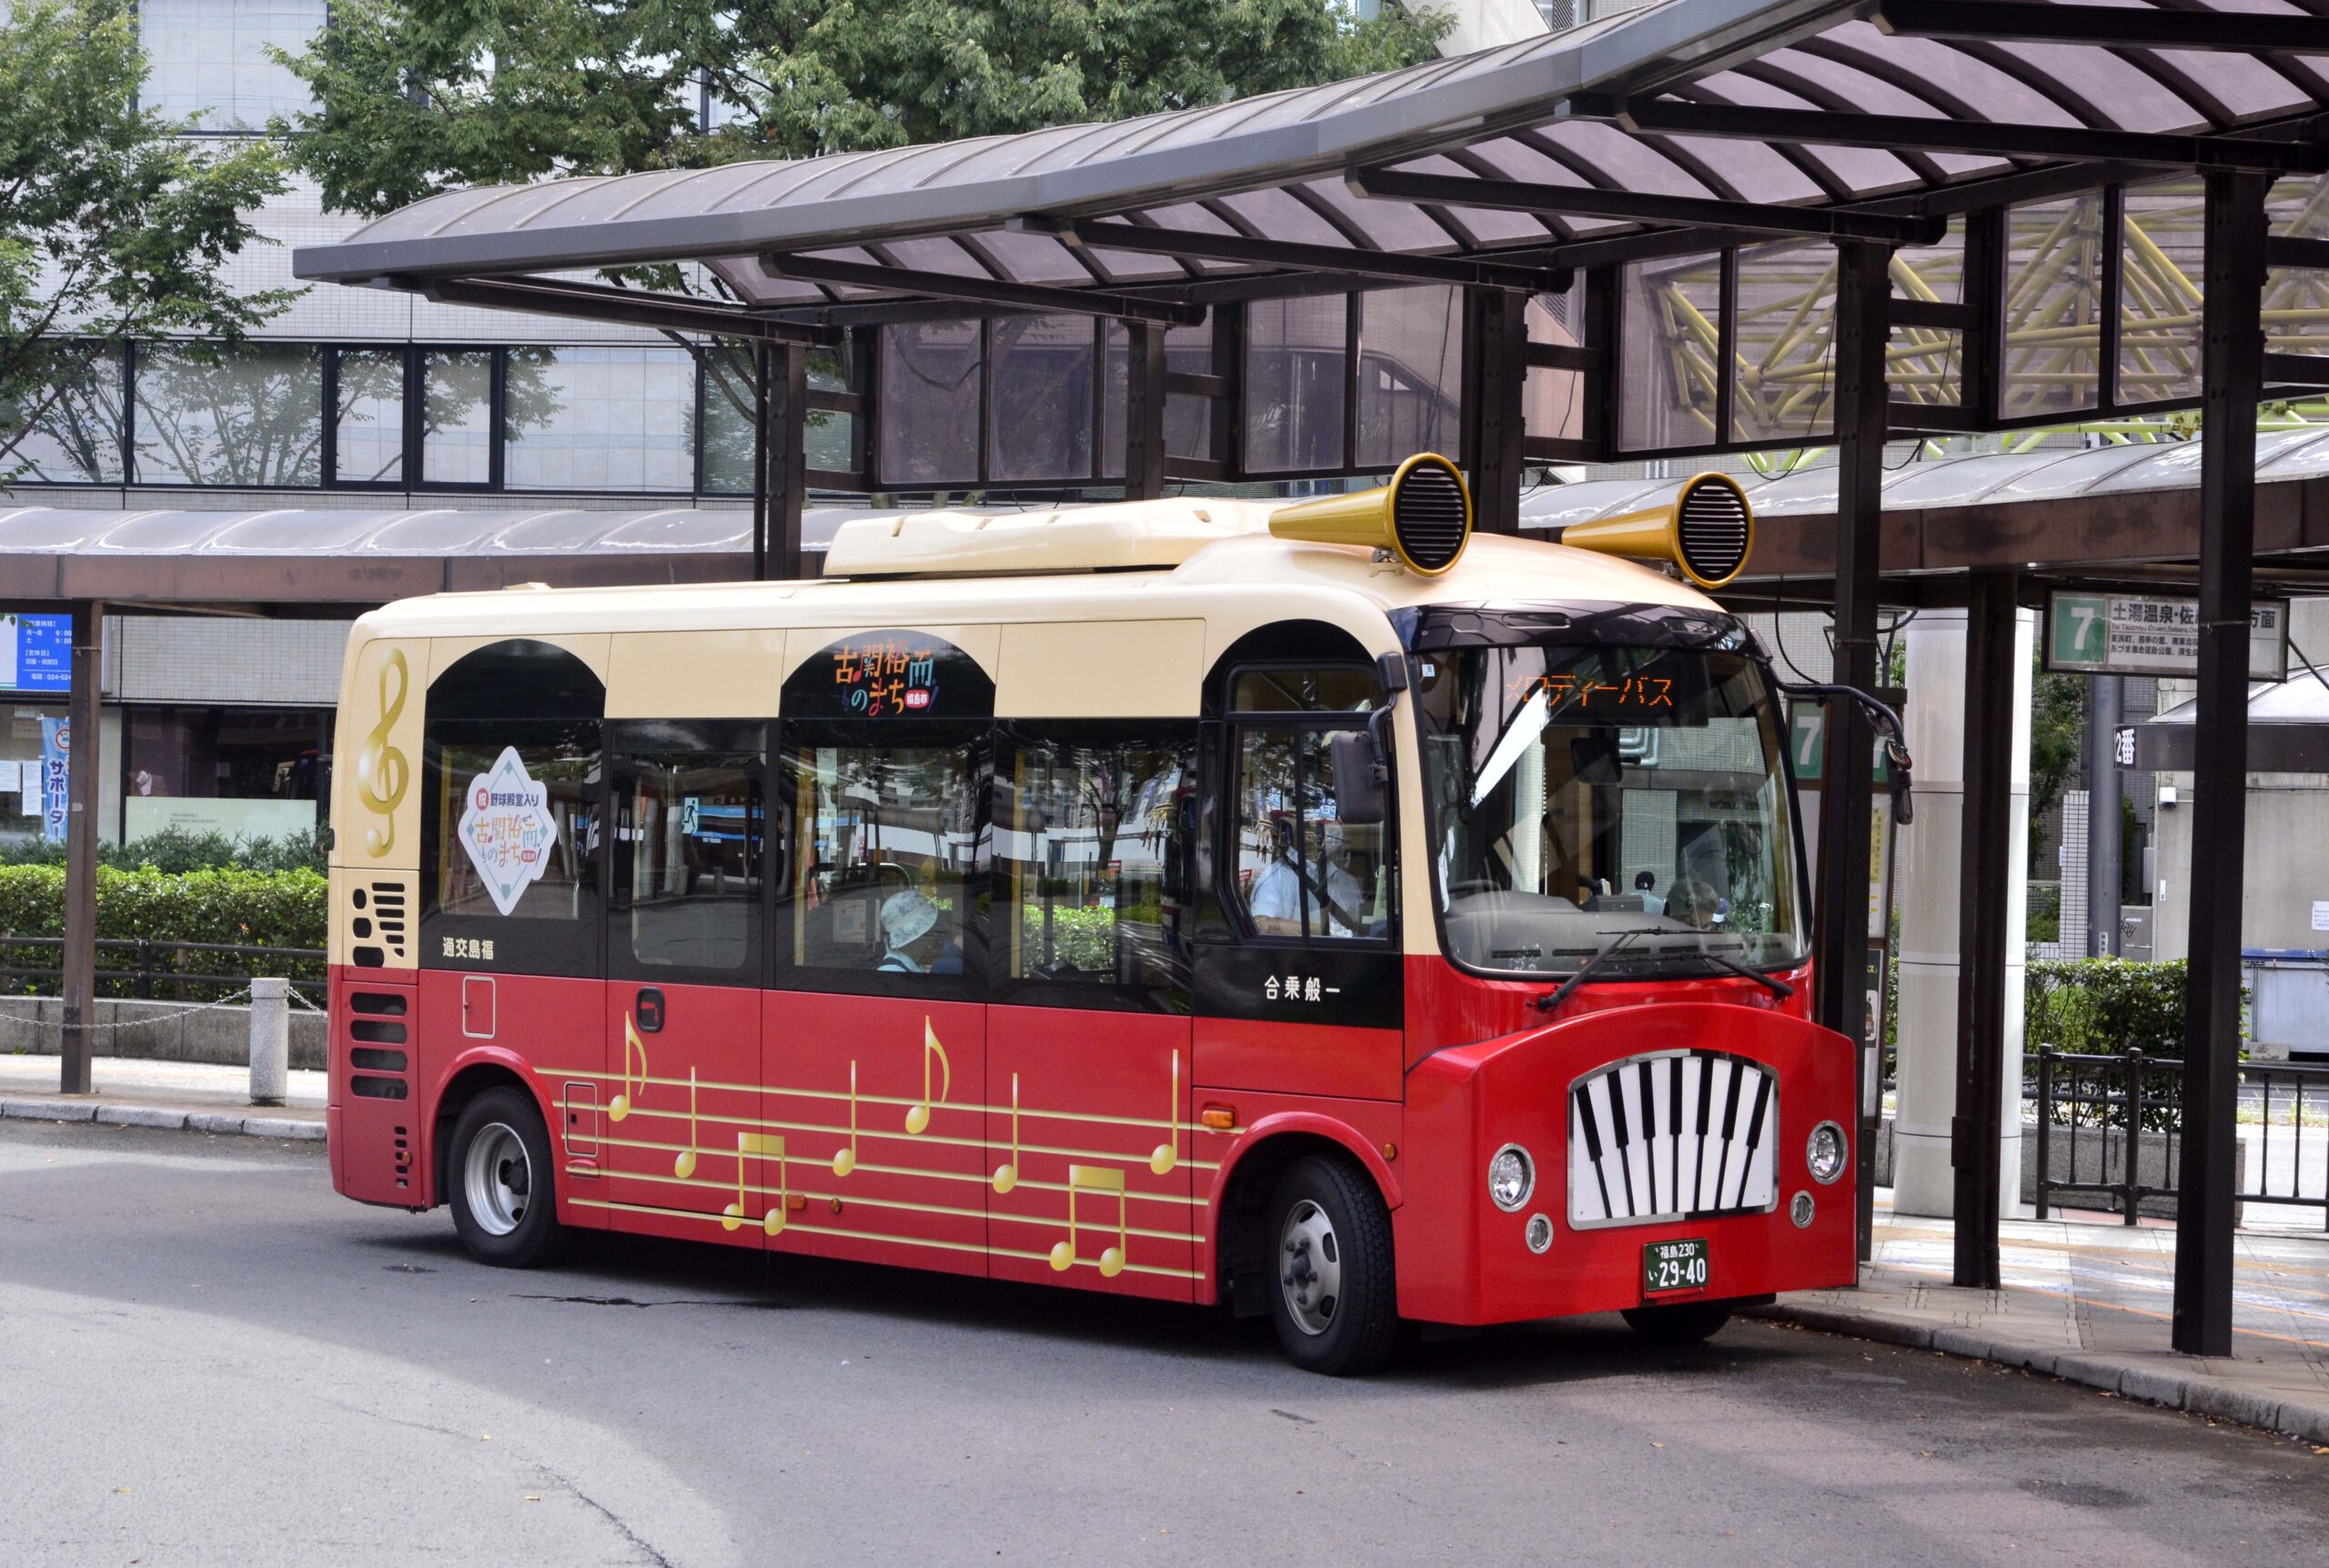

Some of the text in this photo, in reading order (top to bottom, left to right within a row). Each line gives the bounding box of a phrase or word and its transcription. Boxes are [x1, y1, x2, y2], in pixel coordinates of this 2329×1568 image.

[2071, 607, 2094, 649] 7
[2112, 603, 2198, 625] 土湯温泉・佐
[1797, 716, 1821, 766] 7
[490, 792, 539, 808] 野球殿堂入り
[1648, 1258, 1706, 1287] い 29-40
